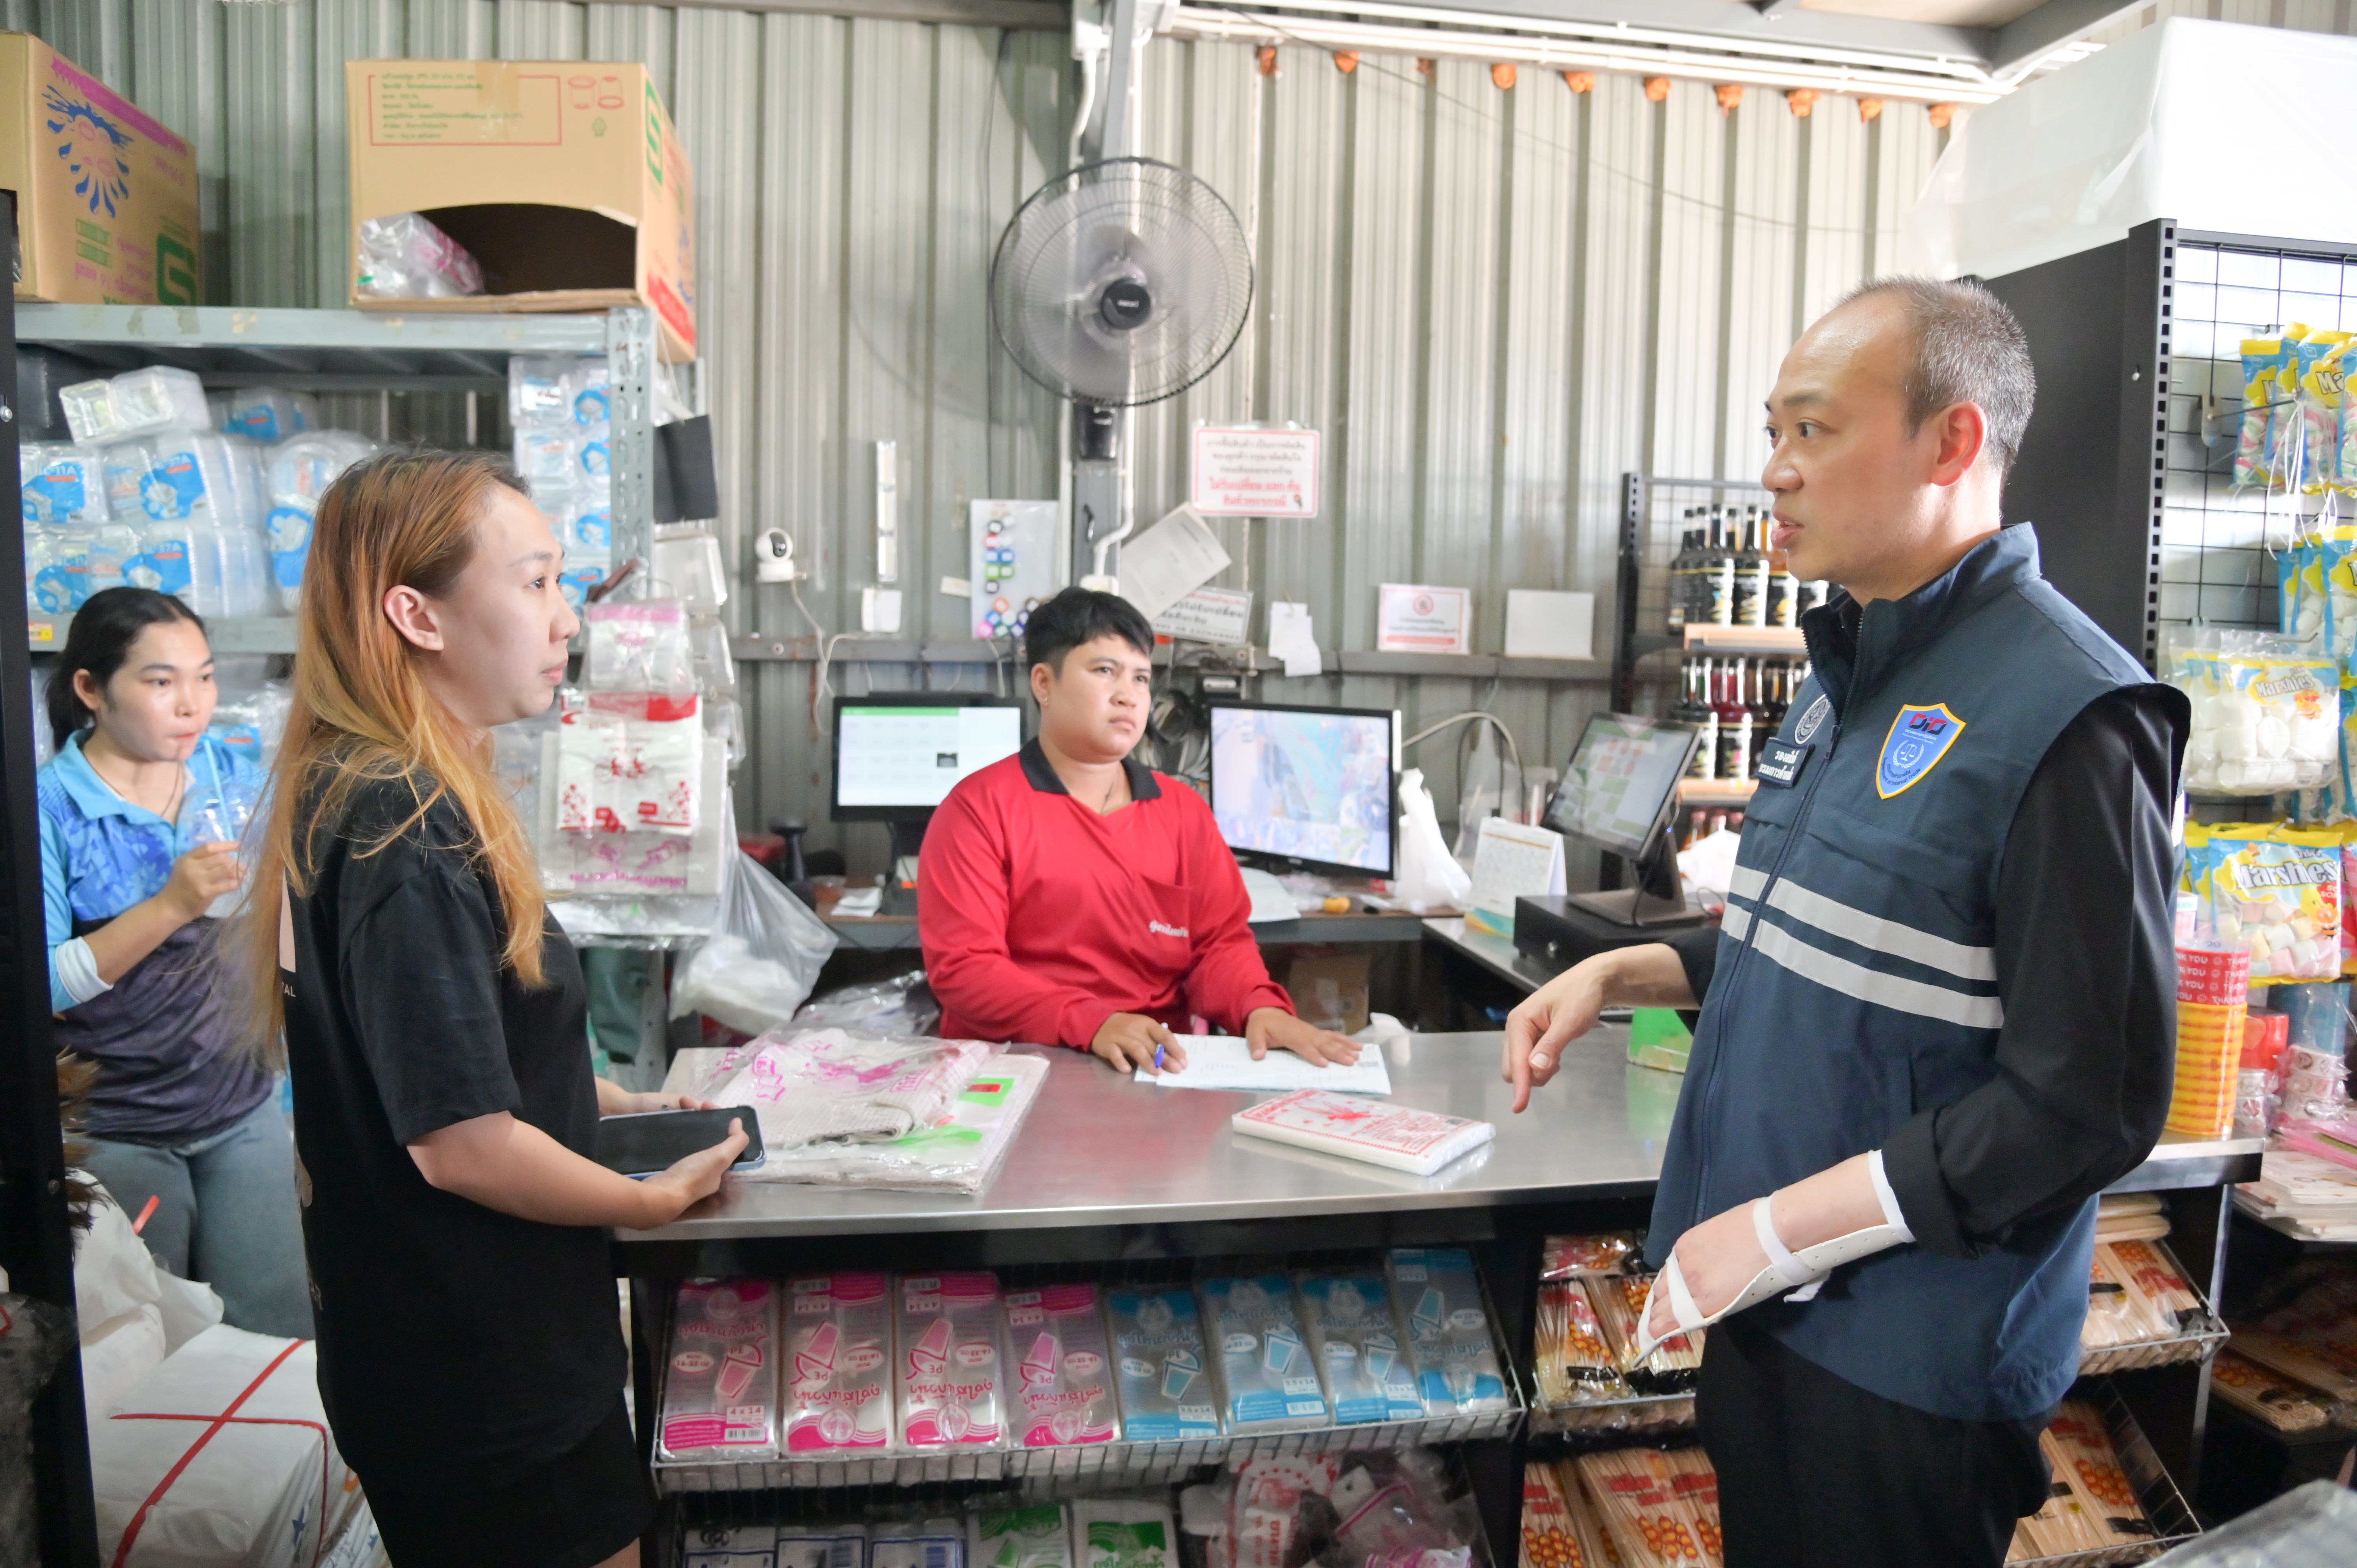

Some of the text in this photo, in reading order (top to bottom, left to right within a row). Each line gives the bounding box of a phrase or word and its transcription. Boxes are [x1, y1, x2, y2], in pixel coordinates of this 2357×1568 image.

[2255, 675, 2315, 697] Marshies
[1908, 768, 1921, 780] Trade
[2189, 955, 2208, 964] YOU
[2187, 968, 2206, 977] YOU
[2186, 980, 2205, 989] YOU
[730, 1346, 744, 1354] PE
[929, 1364, 943, 1373] PE
[815, 1371, 829, 1381] PE
[1039, 1375, 1053, 1383] PE
